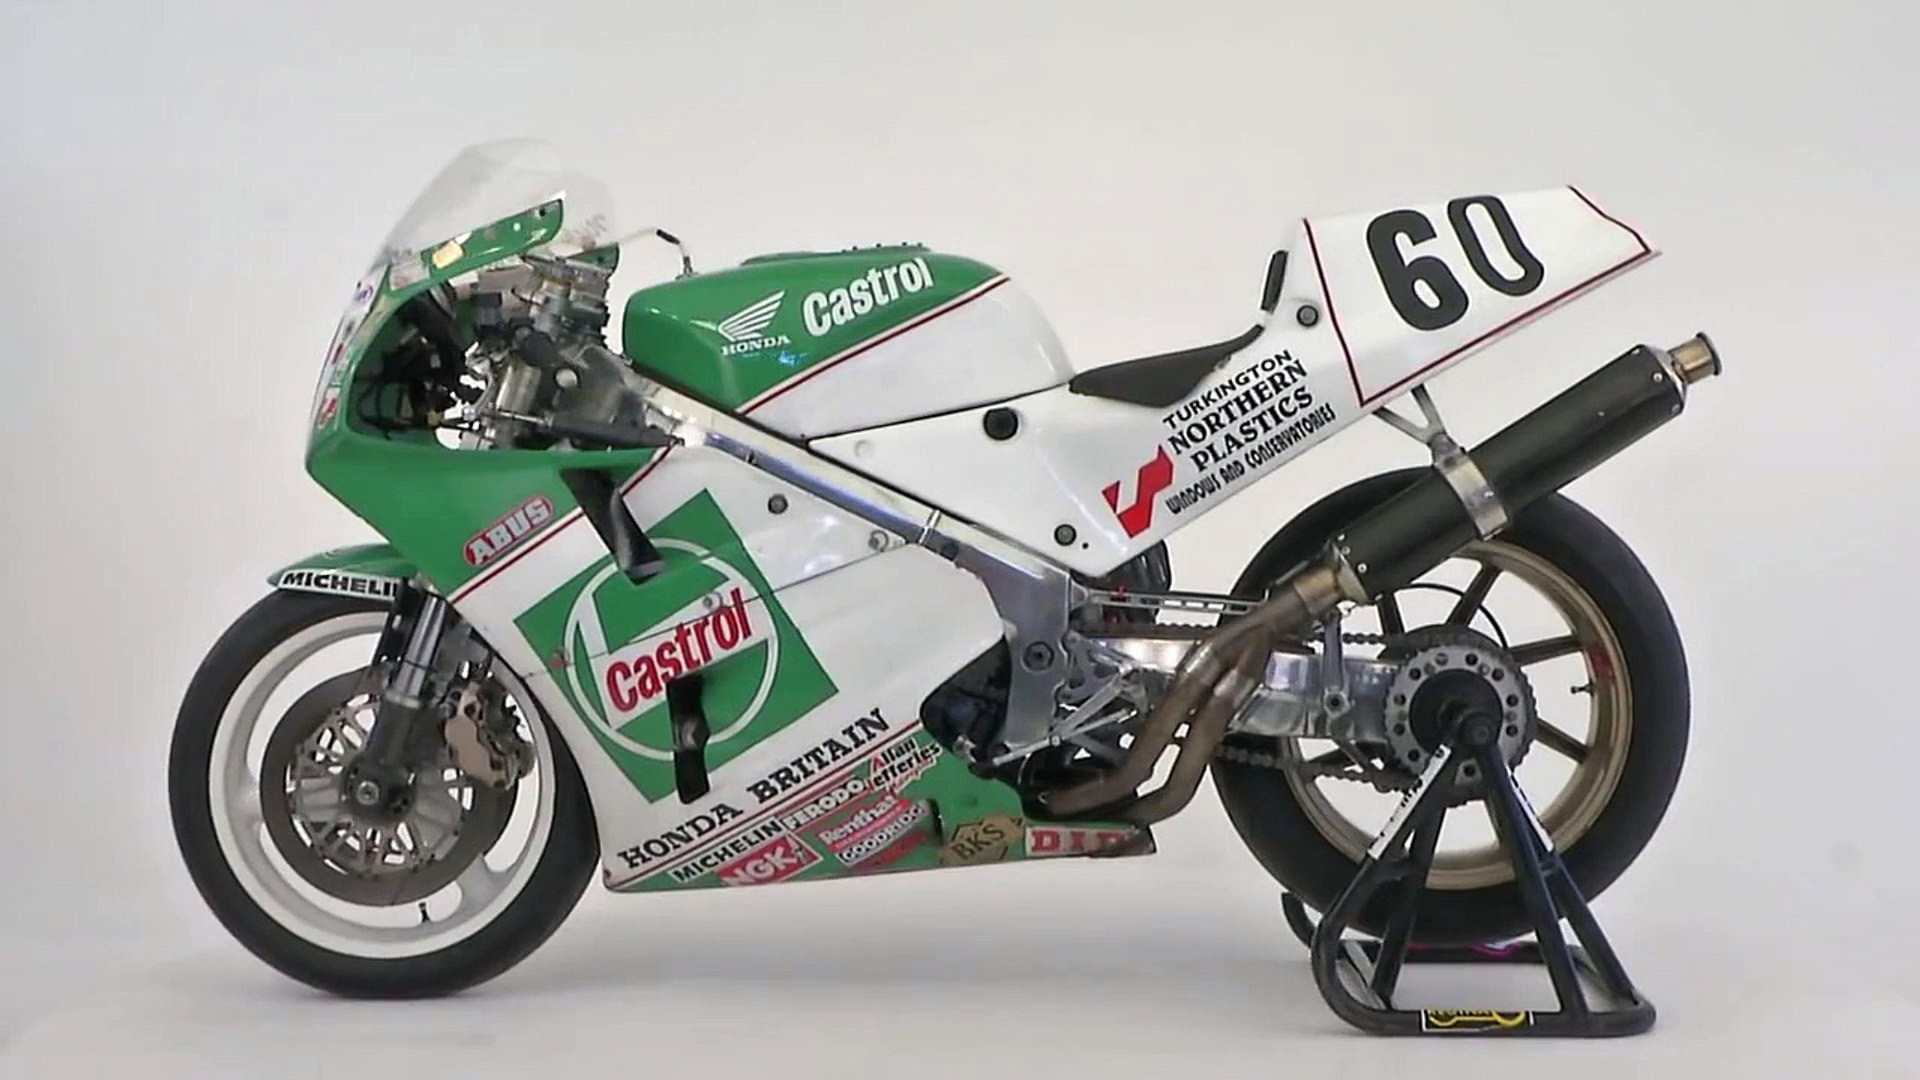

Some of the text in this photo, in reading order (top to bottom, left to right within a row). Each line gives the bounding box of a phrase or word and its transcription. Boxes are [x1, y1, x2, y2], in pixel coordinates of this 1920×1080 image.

[803, 257, 934, 337] Castrol
[1366, 195, 1545, 331] 60
[720, 335, 791, 355] HONDA
[1163, 350, 1293, 430] TURKINGTON
[1167, 359, 1308, 455] NORTHERN
[1190, 386, 1314, 472] PLASTICS
[1165, 402, 1337, 515] WINDOWS AND CONSERVATORIES
[466, 497, 549, 565] ABUS
[282, 571, 398, 598] MICHELI
[606, 587, 753, 712] Castrol
[617, 803, 744, 869] HONDA
[746, 707, 890, 804] BRITAIN
[782, 779, 865, 830] FERODO
[672, 820, 783, 882] MICHELIN
[952, 823, 1006, 860] BKS
